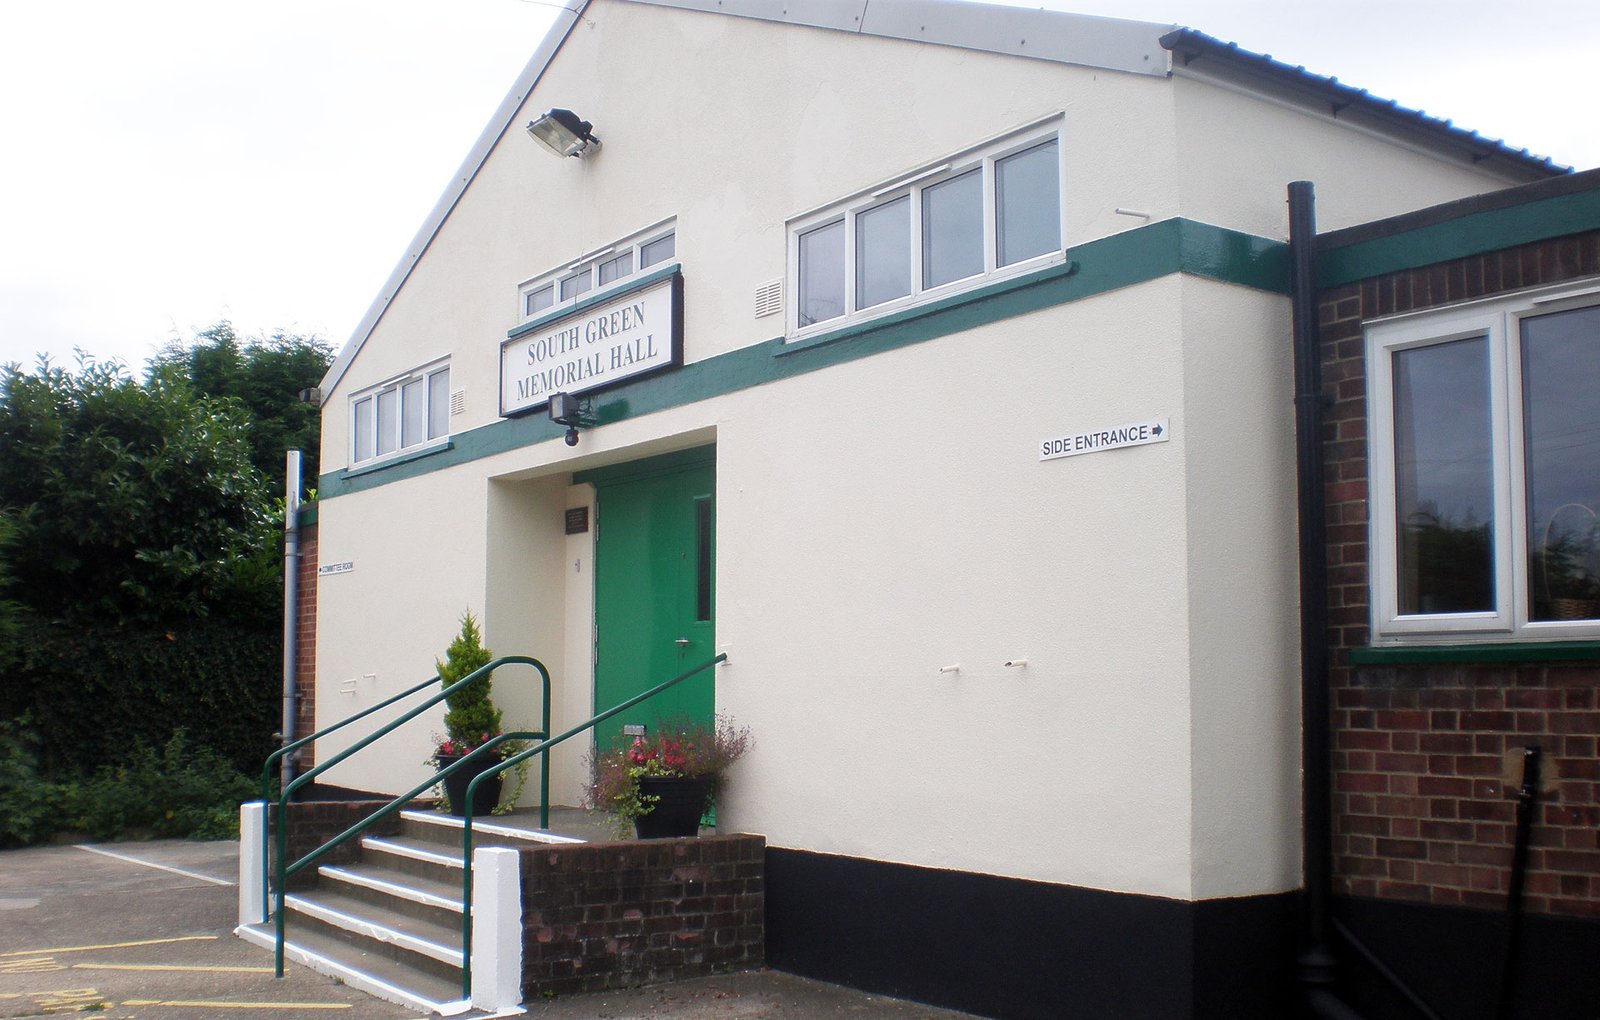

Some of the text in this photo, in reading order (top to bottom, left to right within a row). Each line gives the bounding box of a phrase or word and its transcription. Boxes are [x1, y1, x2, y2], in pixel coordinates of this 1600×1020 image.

[527, 301, 646, 366] SOUTH GREEN
[517, 334, 658, 401] MEMORIAL HALL
[1042, 425, 1148, 456] SIDE ENTRANCE
